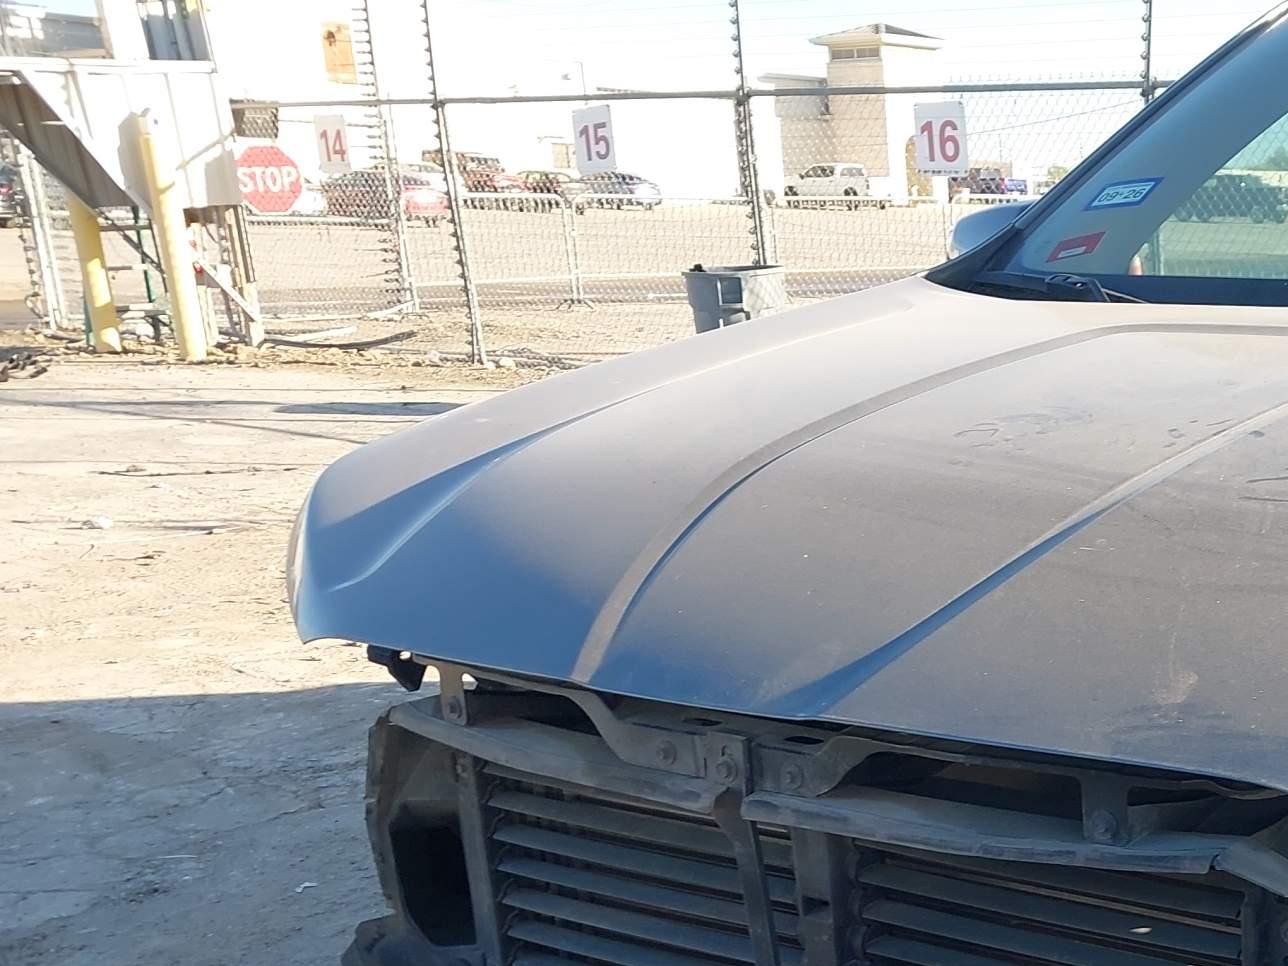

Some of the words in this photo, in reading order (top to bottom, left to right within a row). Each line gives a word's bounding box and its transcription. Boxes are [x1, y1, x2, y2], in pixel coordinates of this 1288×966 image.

[320, 129, 346, 162] 14
[579, 122, 610, 162] 15
[920, 120, 960, 163] 16
[239, 166, 298, 192] STOP
